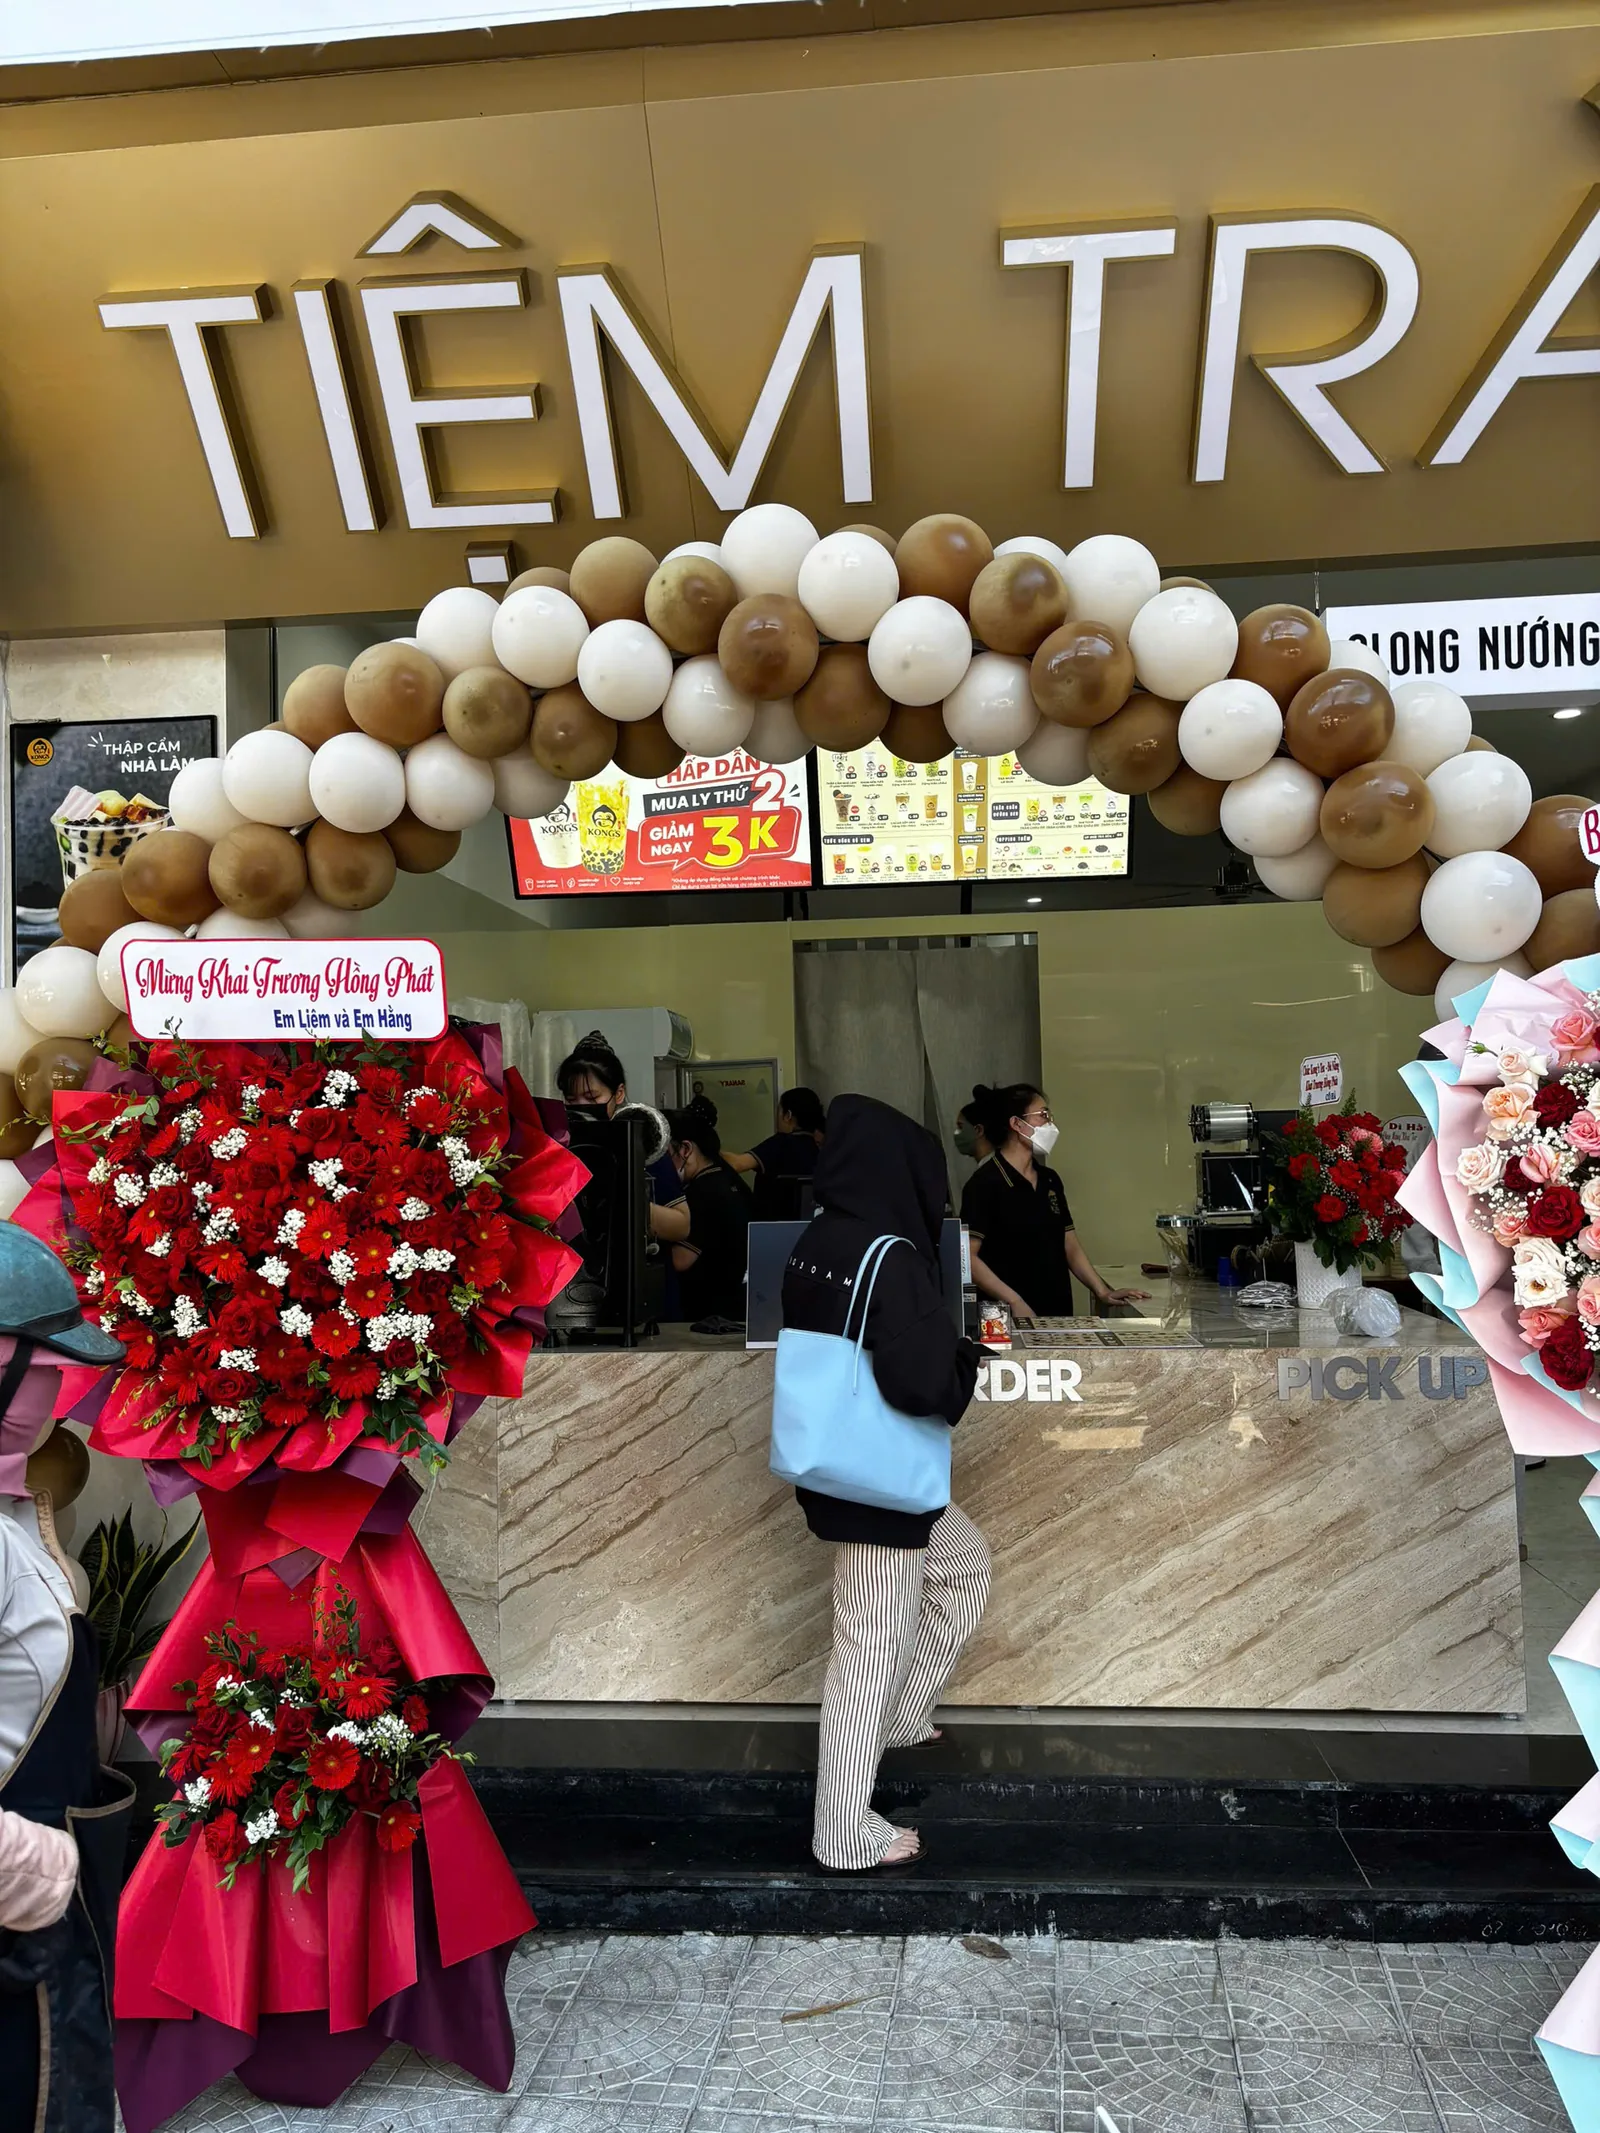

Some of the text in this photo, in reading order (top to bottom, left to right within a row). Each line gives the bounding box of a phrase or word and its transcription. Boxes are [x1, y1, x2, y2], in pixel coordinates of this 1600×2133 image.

[97, 191, 876, 585] TIỆM
[1348, 616, 1600, 676] ONG NƯỚNG
[103, 737, 181, 758] THẬP CẨM
[121, 756, 158, 773] NHÀ
[715, 748, 761, 776] DẪN
[651, 769, 784, 812] MUA LY THỨ 2
[649, 820, 694, 840] GIẢM
[651, 841, 692, 857] NGAY
[136, 956, 435, 1003] Mừng Khai Trương Hồng Phát
[273, 1009, 295, 1028] Em
[334, 1008, 350, 1028] và
[353, 1009, 374, 1028] Em
[377, 1005, 412, 1032] Hằng
[973, 1359, 1084, 1402] RDER
[1277, 1356, 1489, 1402] PICK UP
